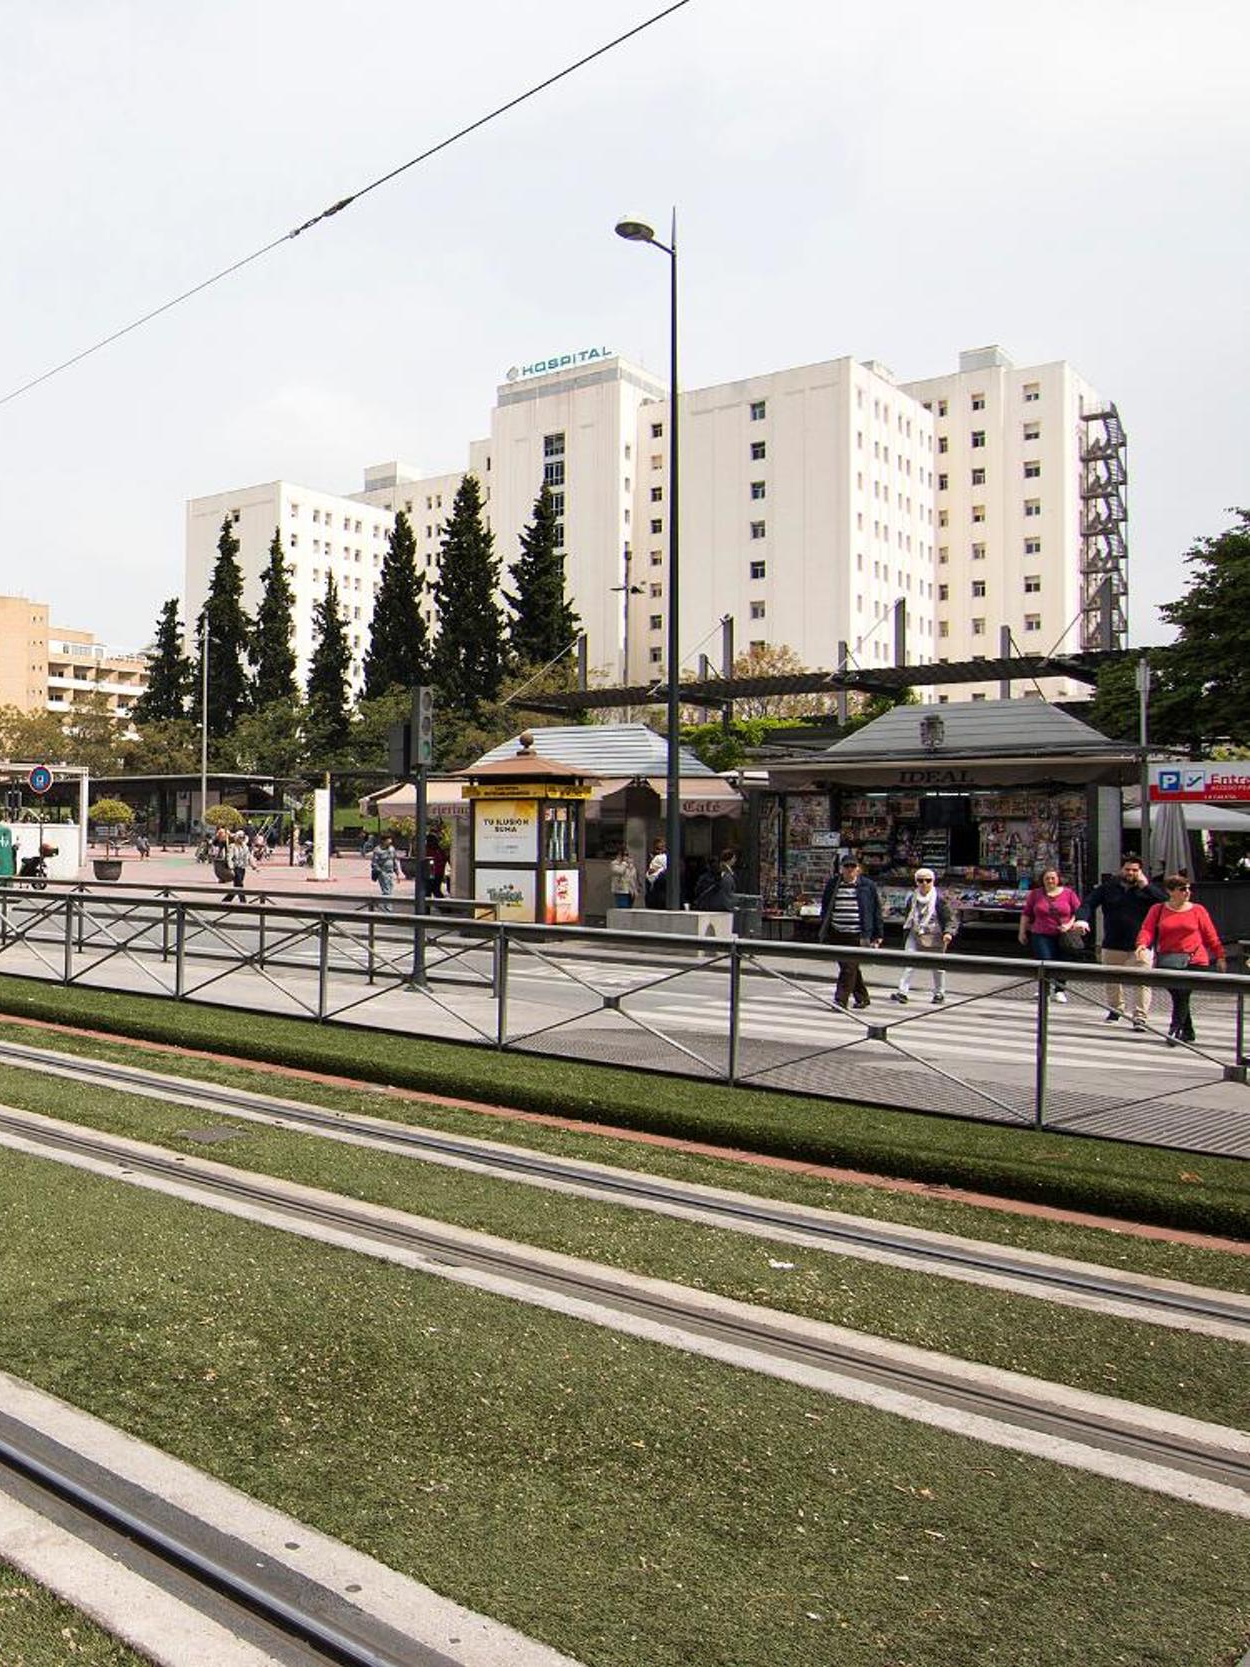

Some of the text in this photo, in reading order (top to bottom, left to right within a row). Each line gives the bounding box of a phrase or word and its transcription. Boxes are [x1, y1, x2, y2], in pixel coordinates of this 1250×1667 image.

[522, 346, 612, 376] HOSPITAL
[898, 770, 975, 783] IDEAL
[682, 800, 721, 813] Café
[483, 817, 530, 826] TU ILUSIÓN
